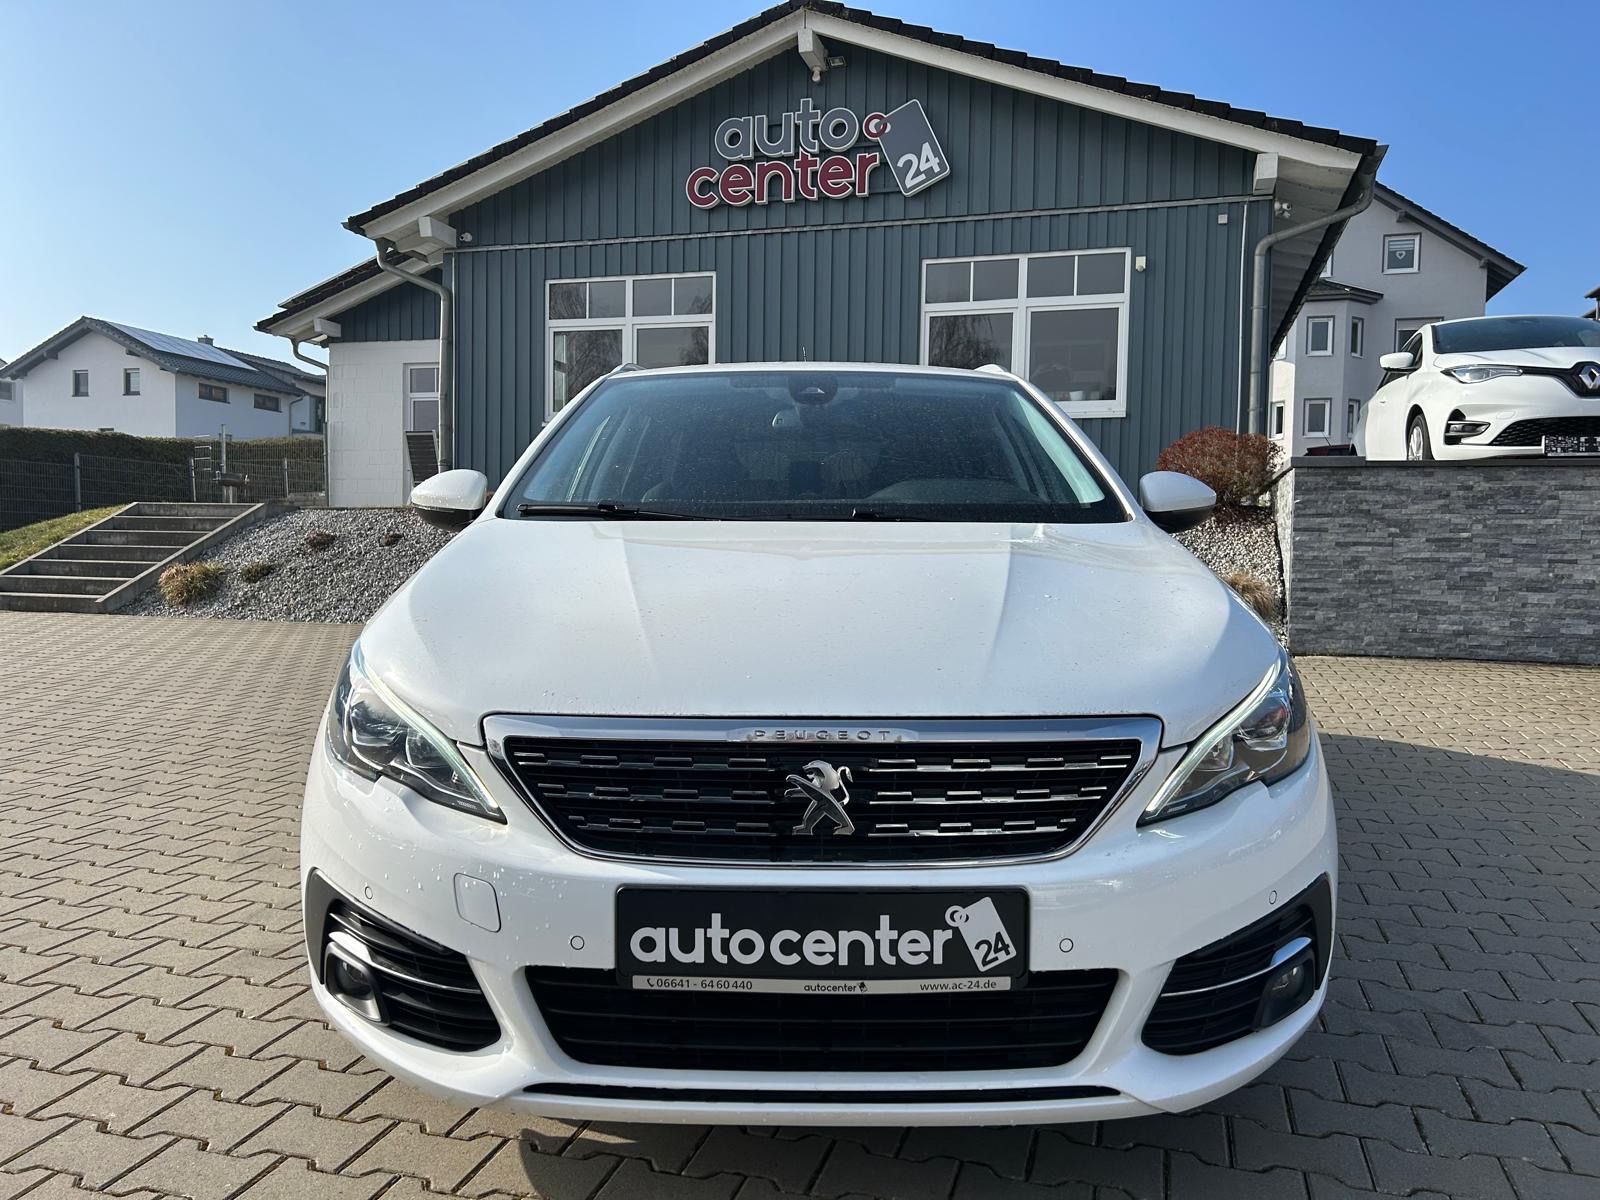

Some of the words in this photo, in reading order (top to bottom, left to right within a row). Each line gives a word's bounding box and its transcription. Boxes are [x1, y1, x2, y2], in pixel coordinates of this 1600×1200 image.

[715, 98, 860, 161] auto
[686, 146, 880, 209] center
[897, 142, 941, 189] 24
[754, 729, 891, 741] PEUGEOT
[630, 912, 953, 966] autocenter
[974, 931, 1011, 967] 24
[804, 983, 857, 993] autocenter
[920, 979, 997, 992] www.ac-24.de
